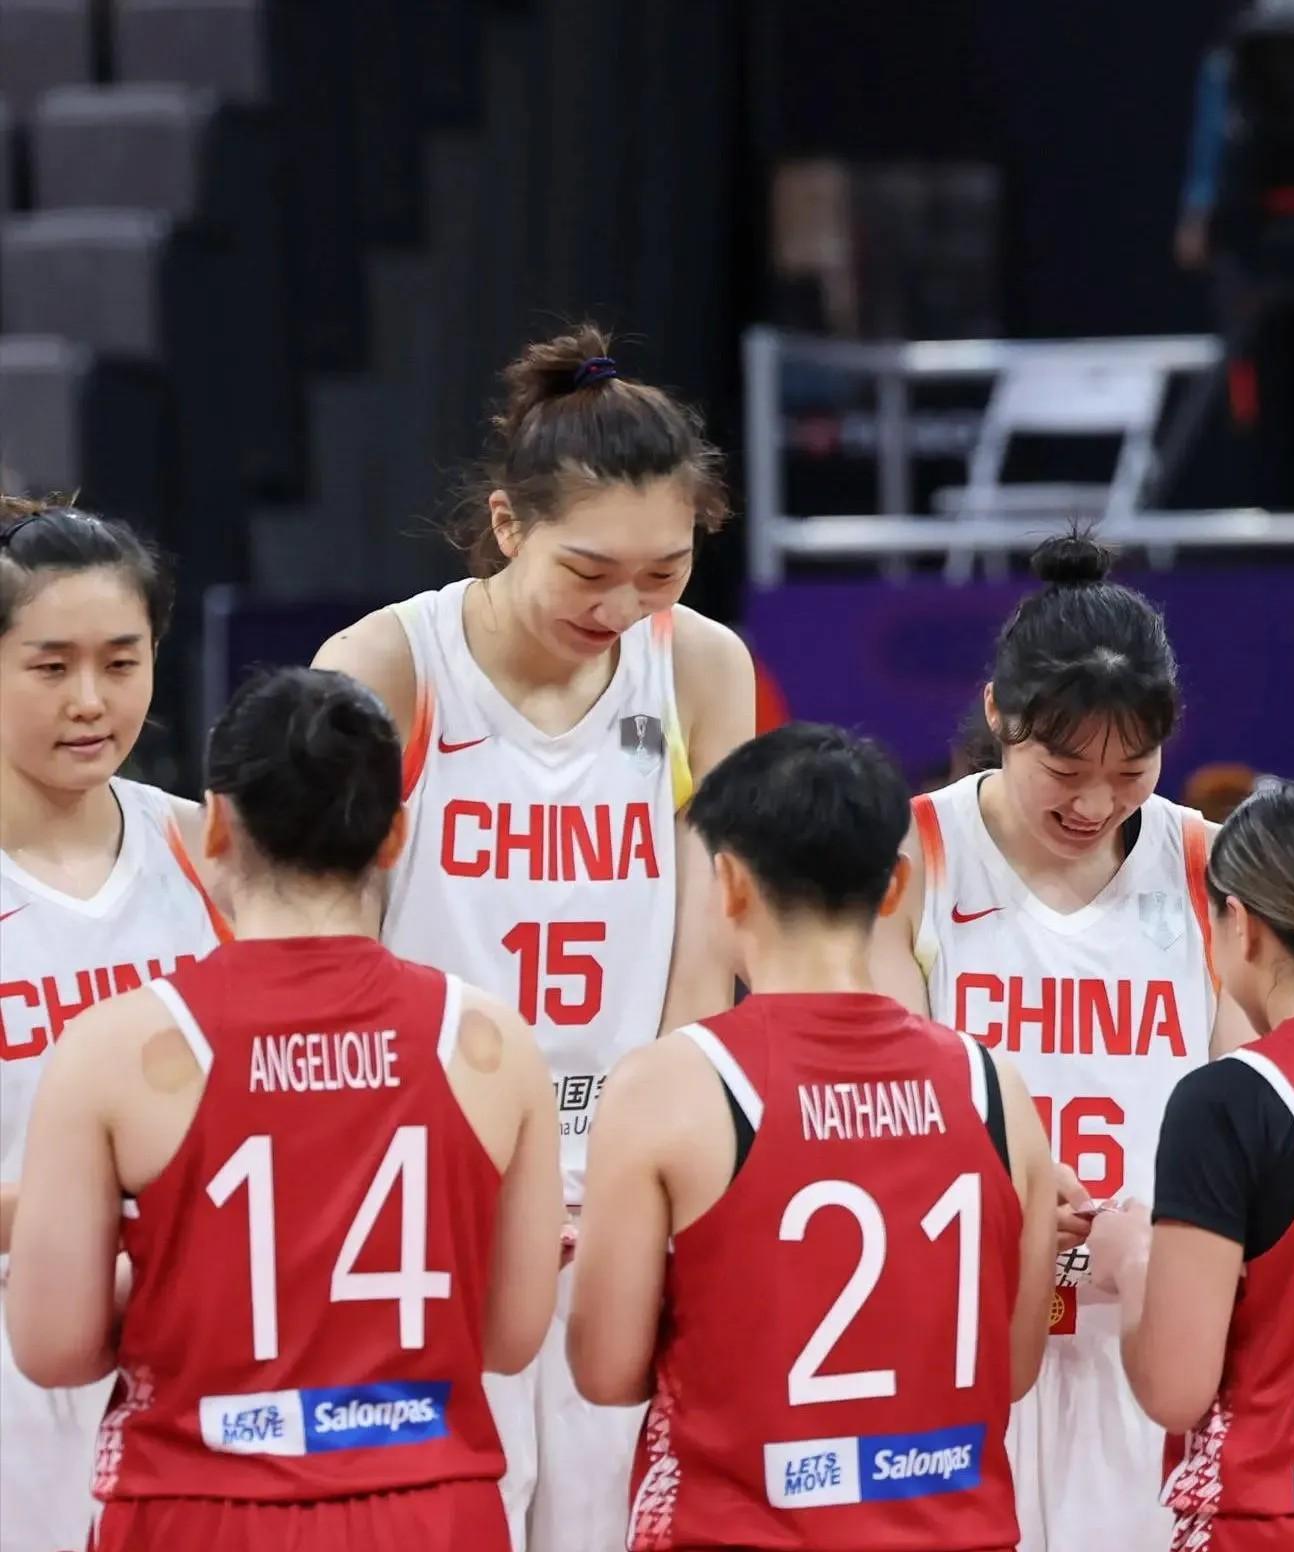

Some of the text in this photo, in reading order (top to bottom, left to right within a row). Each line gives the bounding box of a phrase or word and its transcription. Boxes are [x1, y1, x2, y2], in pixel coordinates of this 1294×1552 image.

[441, 799, 660, 882] CHINA
[501, 921, 606, 1026] 15
[955, 971, 1187, 1056] CHINA
[249, 1029, 400, 1092] ANGELIQUE
[798, 1079, 946, 1141] NATHANIA
[206, 1124, 451, 1361] 14
[779, 1172, 981, 1406] 21
[222, 1419, 285, 1446] MOVE
[314, 1397, 435, 1433] Salonpas
[784, 1466, 841, 1496] MOVE
